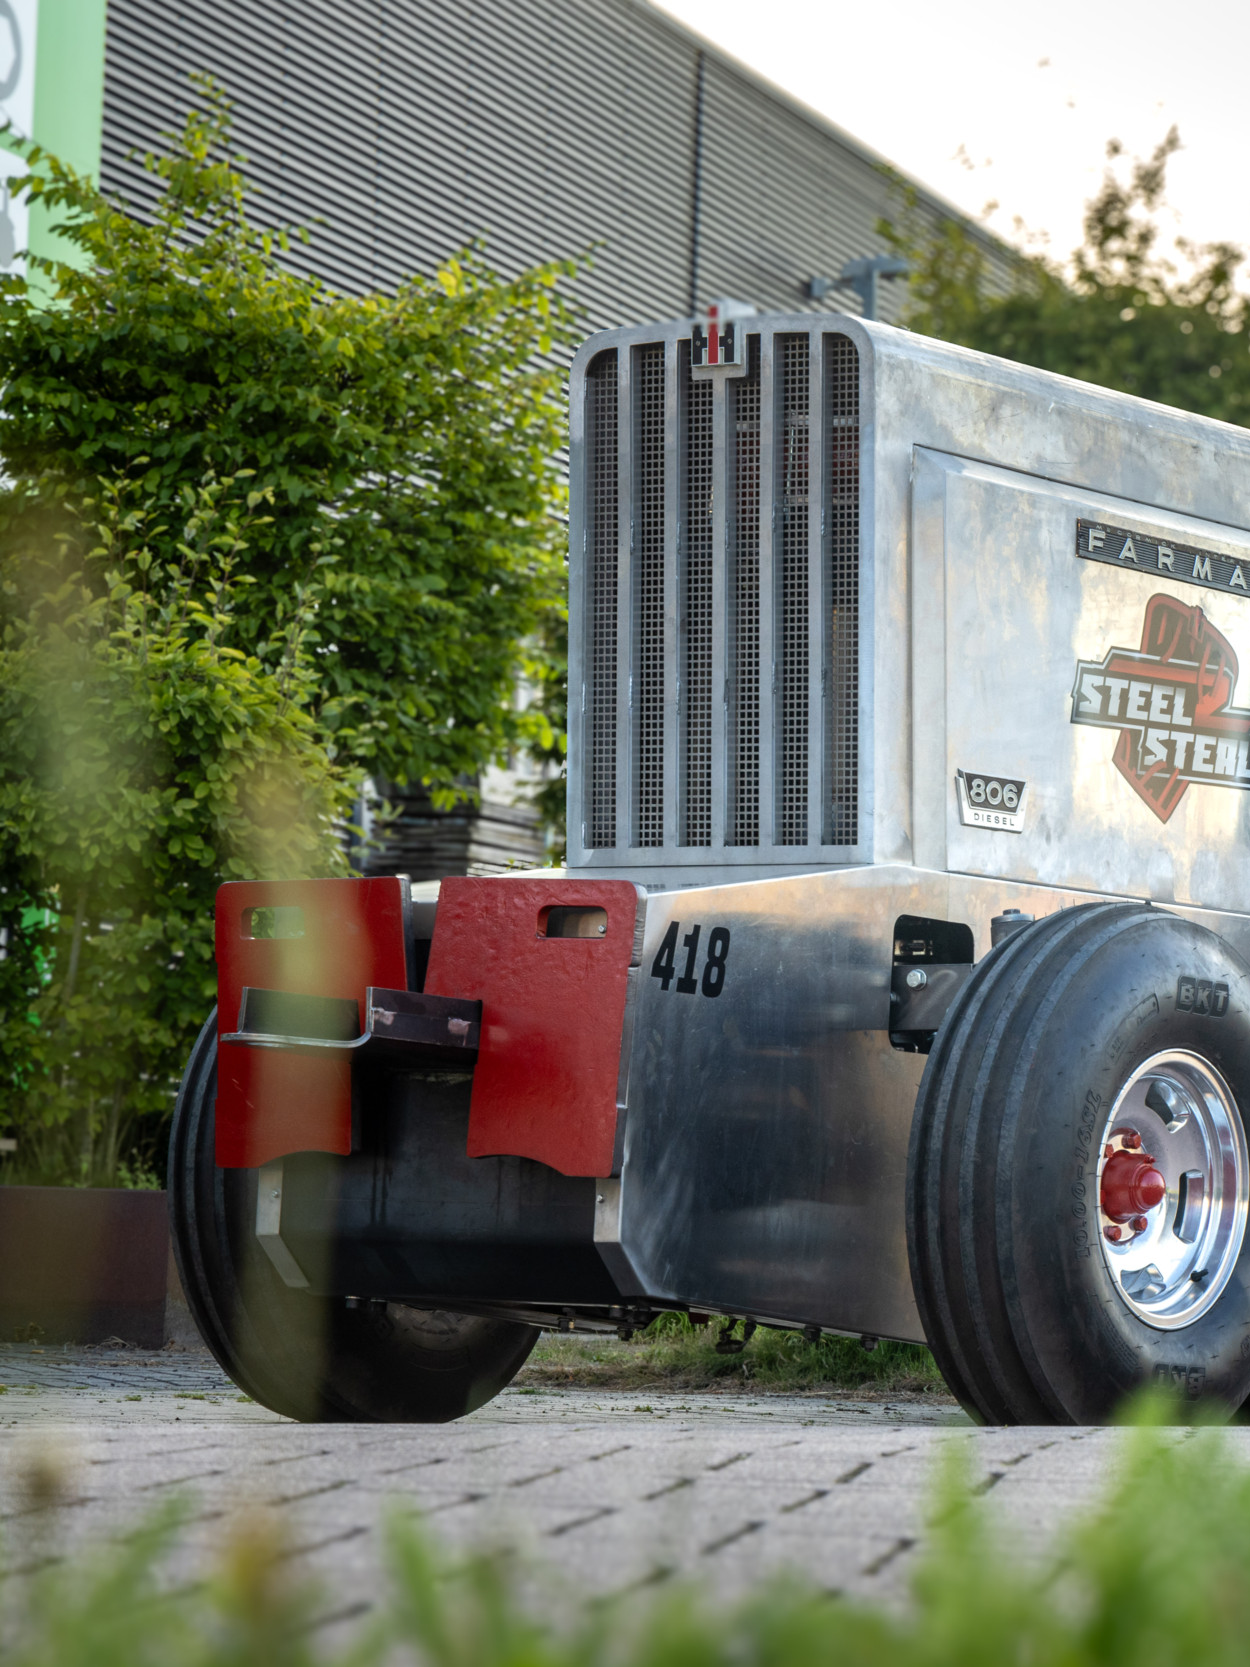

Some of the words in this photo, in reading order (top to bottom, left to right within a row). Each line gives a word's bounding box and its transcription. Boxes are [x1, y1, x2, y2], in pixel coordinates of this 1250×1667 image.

[1077, 673, 1193, 727] STEEL
[970, 778, 1018, 808] 806
[974, 813, 1014, 826] DIESEL
[651, 921, 730, 998] 418
[1177, 980, 1229, 1015] BKT
